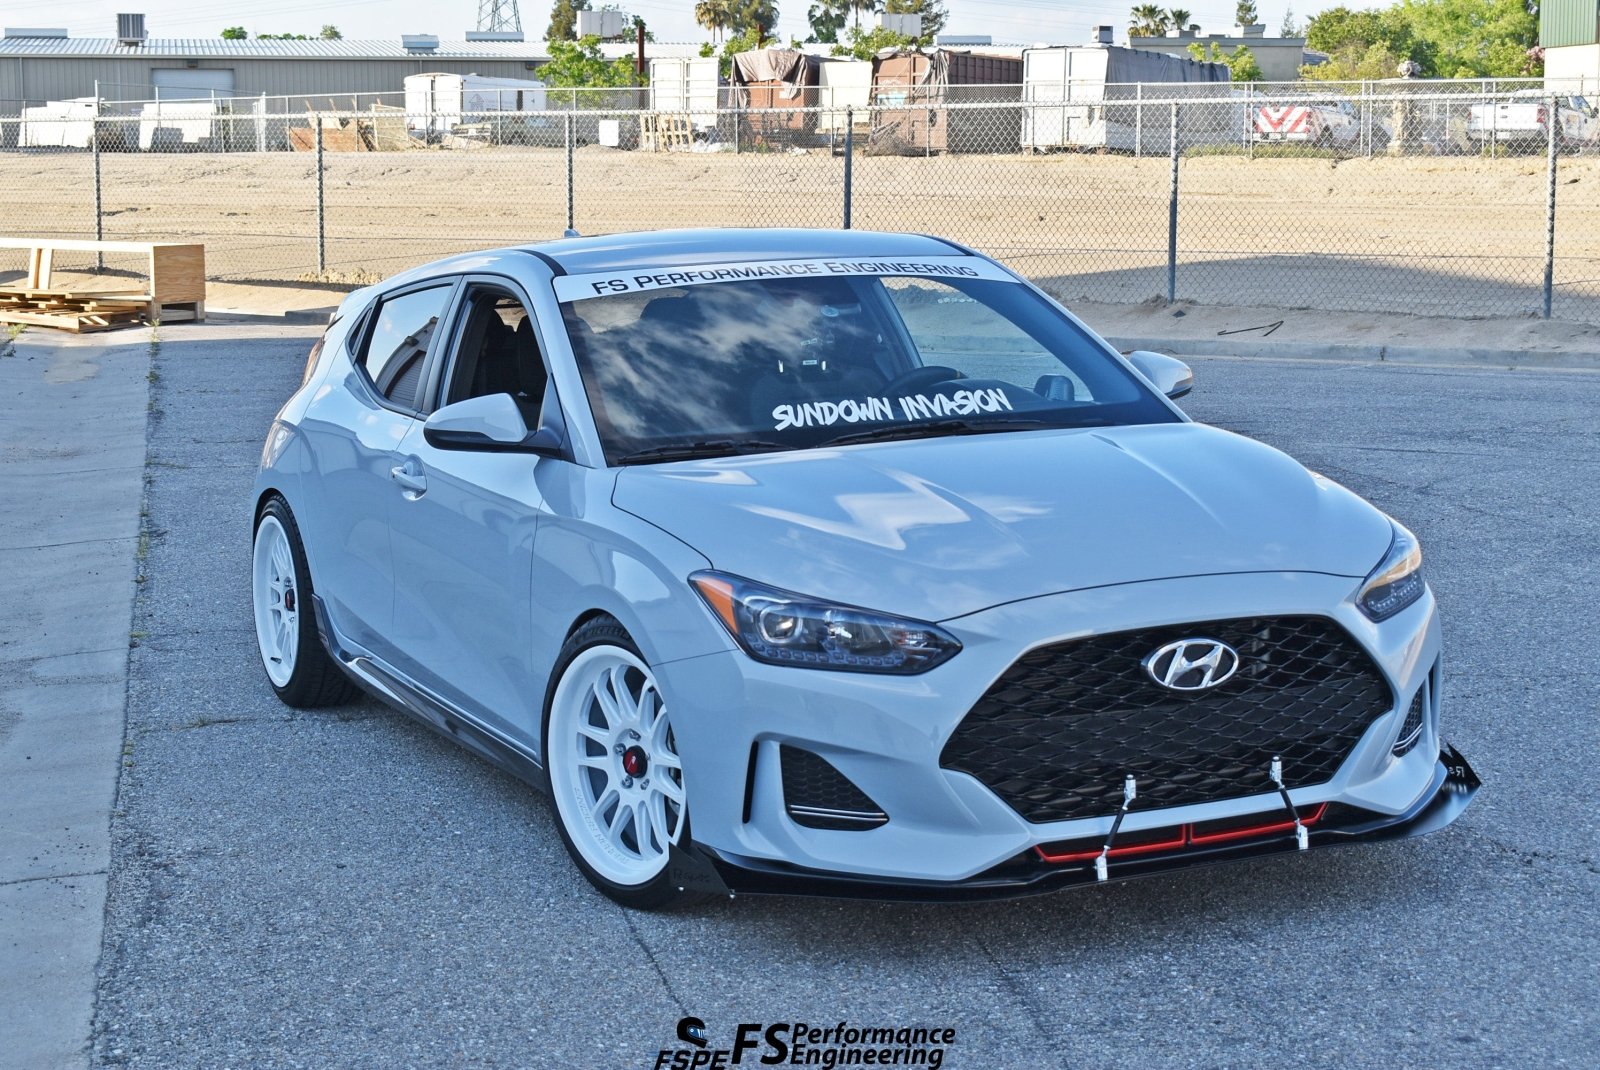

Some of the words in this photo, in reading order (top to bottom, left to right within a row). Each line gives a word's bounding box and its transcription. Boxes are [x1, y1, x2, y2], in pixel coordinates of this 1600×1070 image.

[591, 279, 629, 295] FS
[633, 263, 823, 289] PERFORMANCE
[824, 262, 979, 277] ENGINEERING
[772, 397, 895, 431] SUNDOWN
[899, 388, 1014, 421] INVASION
